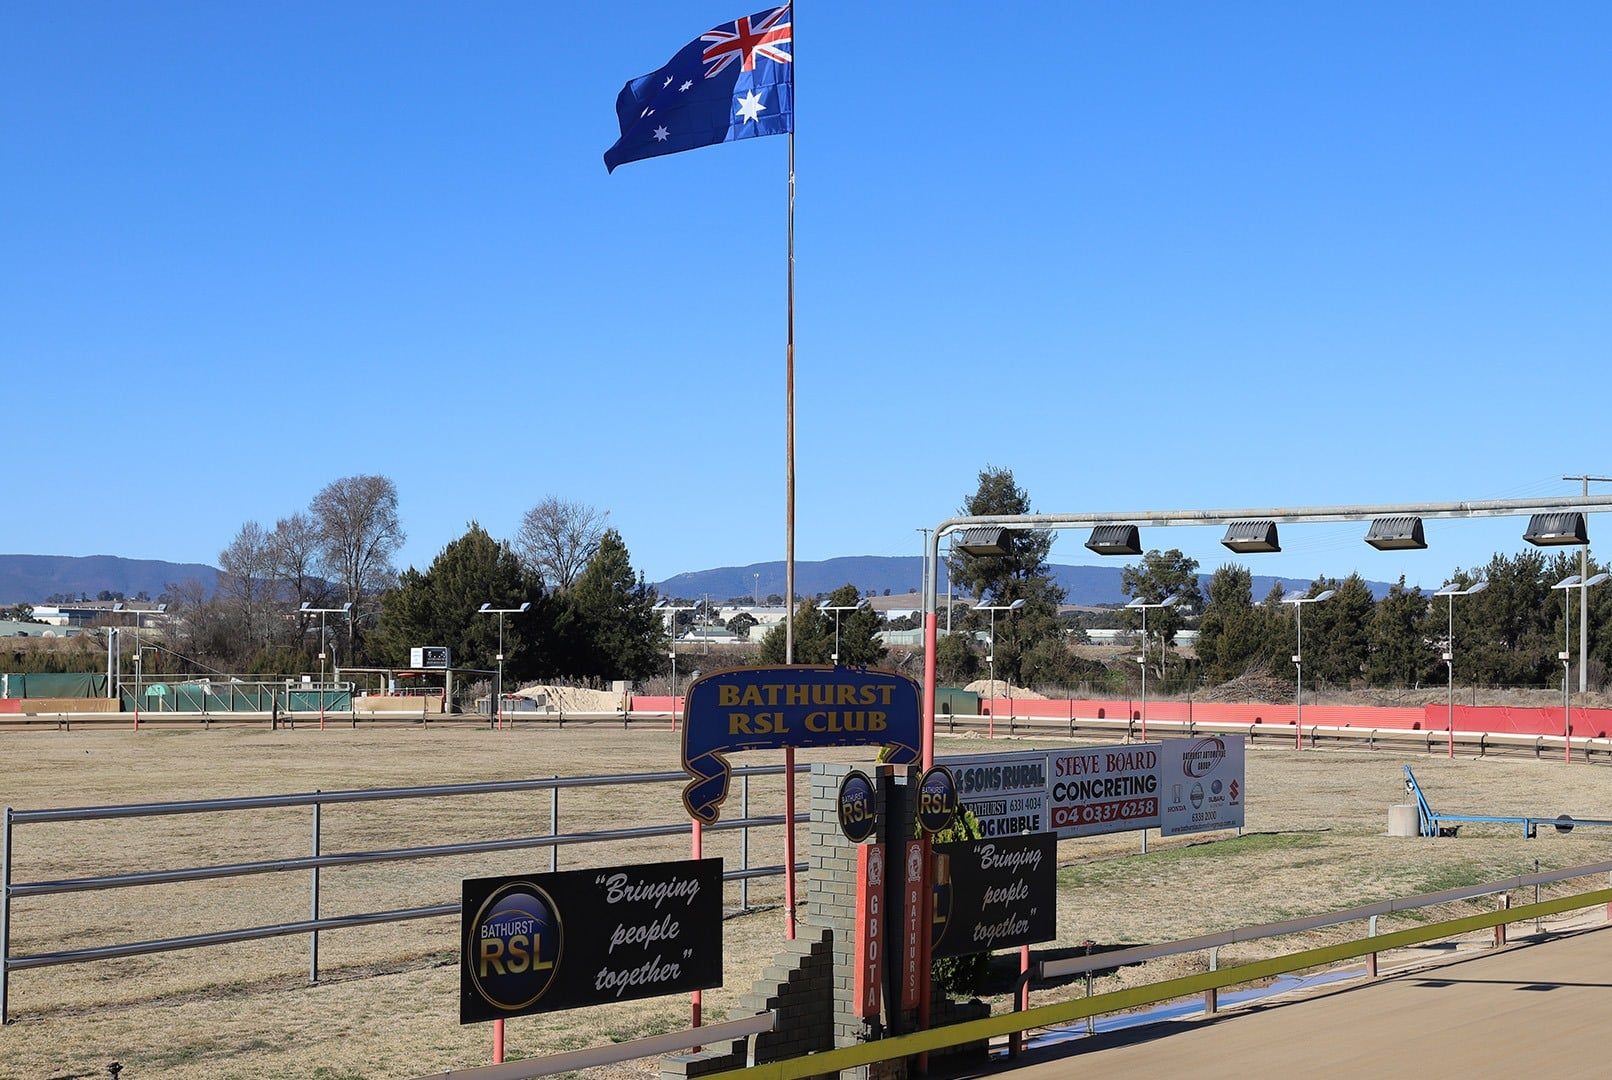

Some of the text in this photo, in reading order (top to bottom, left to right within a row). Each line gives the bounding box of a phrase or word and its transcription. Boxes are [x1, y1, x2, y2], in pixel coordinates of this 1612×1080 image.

[718, 684, 897, 707] BATHURST
[728, 710, 887, 735] RSL CLUB
[1055, 750, 1157, 777] STEVE BOARD
[922, 786, 944, 794] BATHURST
[964, 766, 1002, 794] SONS
[1002, 763, 1045, 790] RURAL
[1052, 774, 1157, 802] CONCRETING
[842, 798, 873, 825] RSL
[920, 793, 952, 815] RSL
[1055, 807, 1080, 825] 04
[1167, 804, 1187, 813] HONDA
[979, 814, 1040, 838] OG KIBBLE
[981, 877, 1029, 912] people
[481, 919, 534, 939] BATHURST
[608, 913, 680, 954] people
[480, 932, 553, 978] RSL
[867, 894, 879, 1007] GBOTA
[909, 890, 917, 1001] BATHURST
